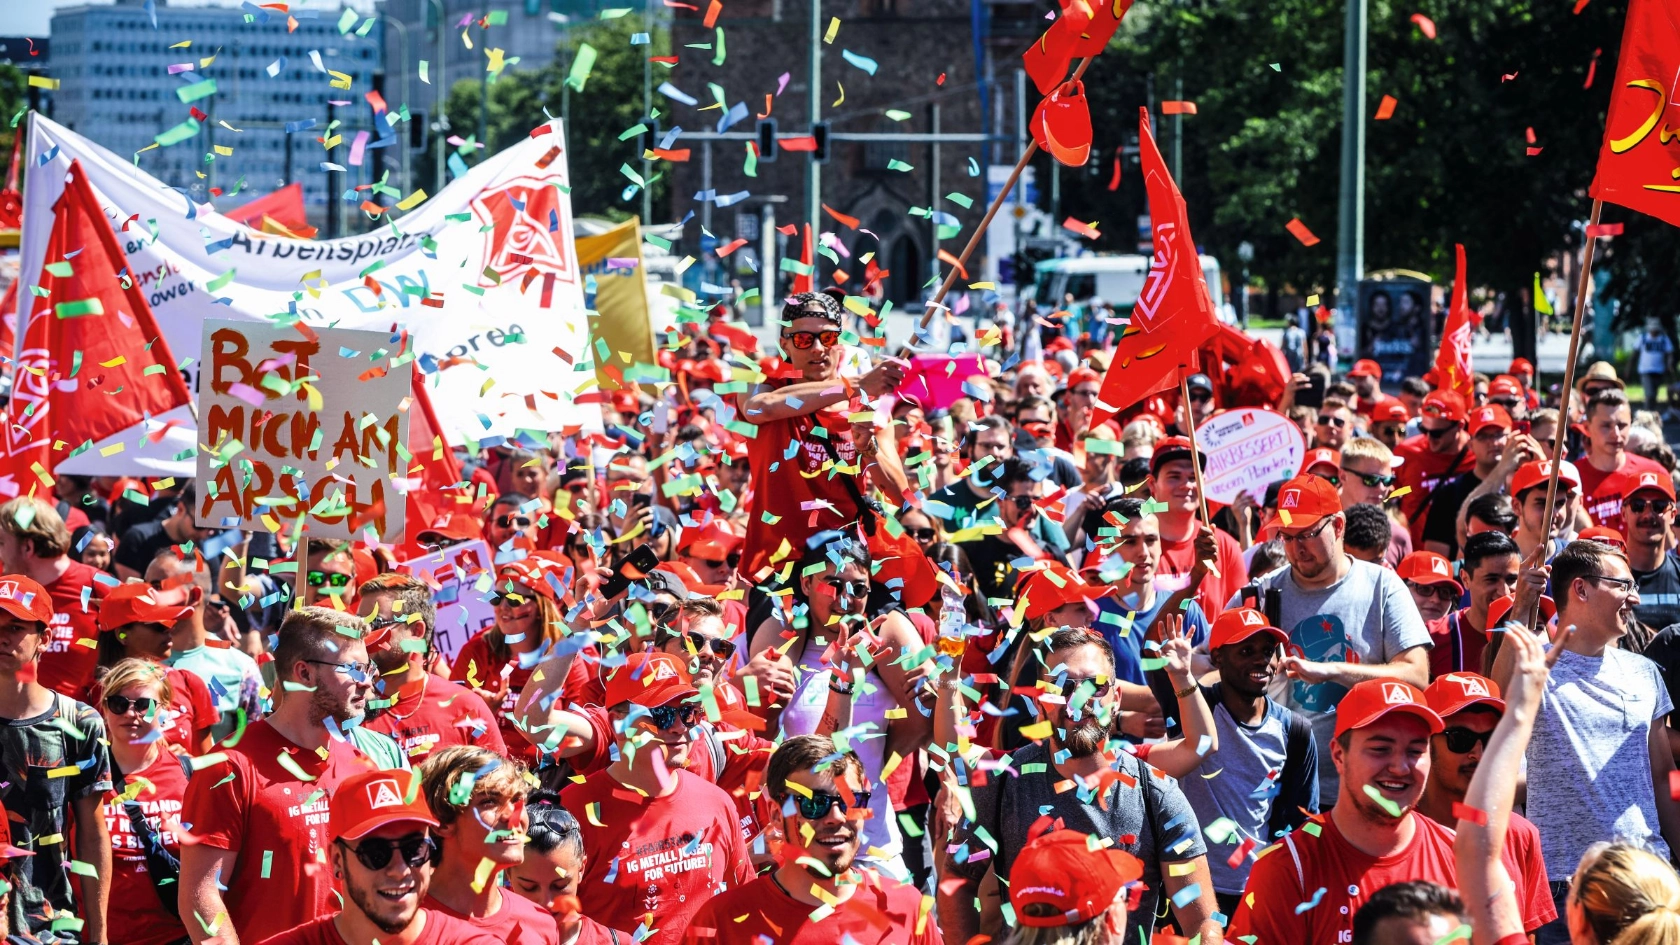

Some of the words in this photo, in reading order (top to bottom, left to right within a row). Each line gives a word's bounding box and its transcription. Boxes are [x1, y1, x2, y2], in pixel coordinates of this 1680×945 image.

[208, 404, 321, 461] MICH
[333, 411, 399, 474] AM
[289, 805, 300, 818] IG
[321, 812, 331, 824] FU
[626, 859, 640, 874] IG
[640, 850, 678, 870] METALL
[644, 866, 664, 882] FOR
[664, 856, 707, 875] FUTURE!
[1338, 929, 1353, 944] IG
